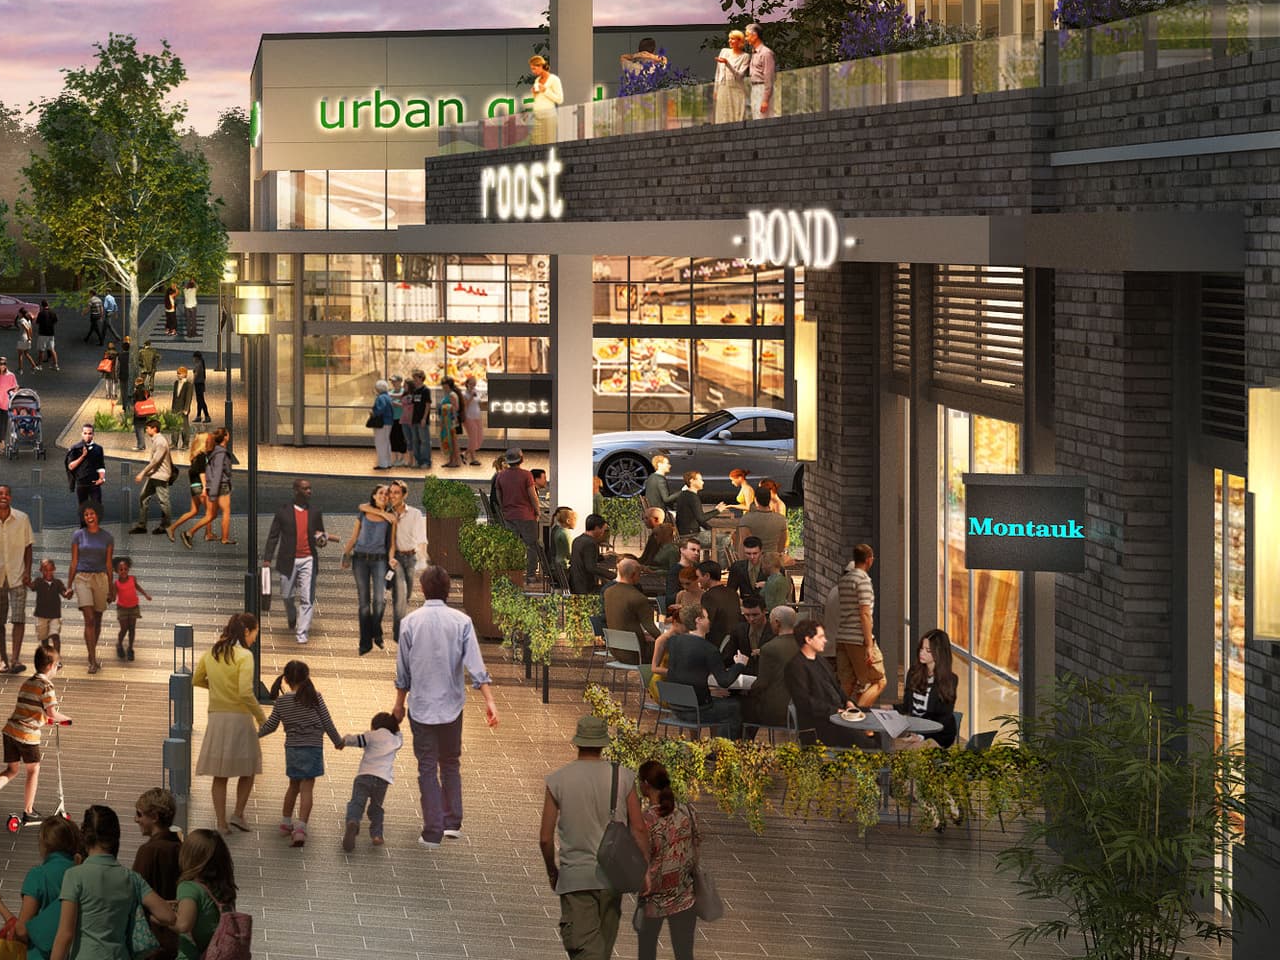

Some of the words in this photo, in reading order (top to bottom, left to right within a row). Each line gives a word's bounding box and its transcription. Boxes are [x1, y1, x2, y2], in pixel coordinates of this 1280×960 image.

[319, 89, 464, 129] urban
[481, 147, 564, 221] roost
[747, 208, 840, 269] BOND
[490, 400, 550, 414] roost
[968, 517, 1086, 539] Montauk
